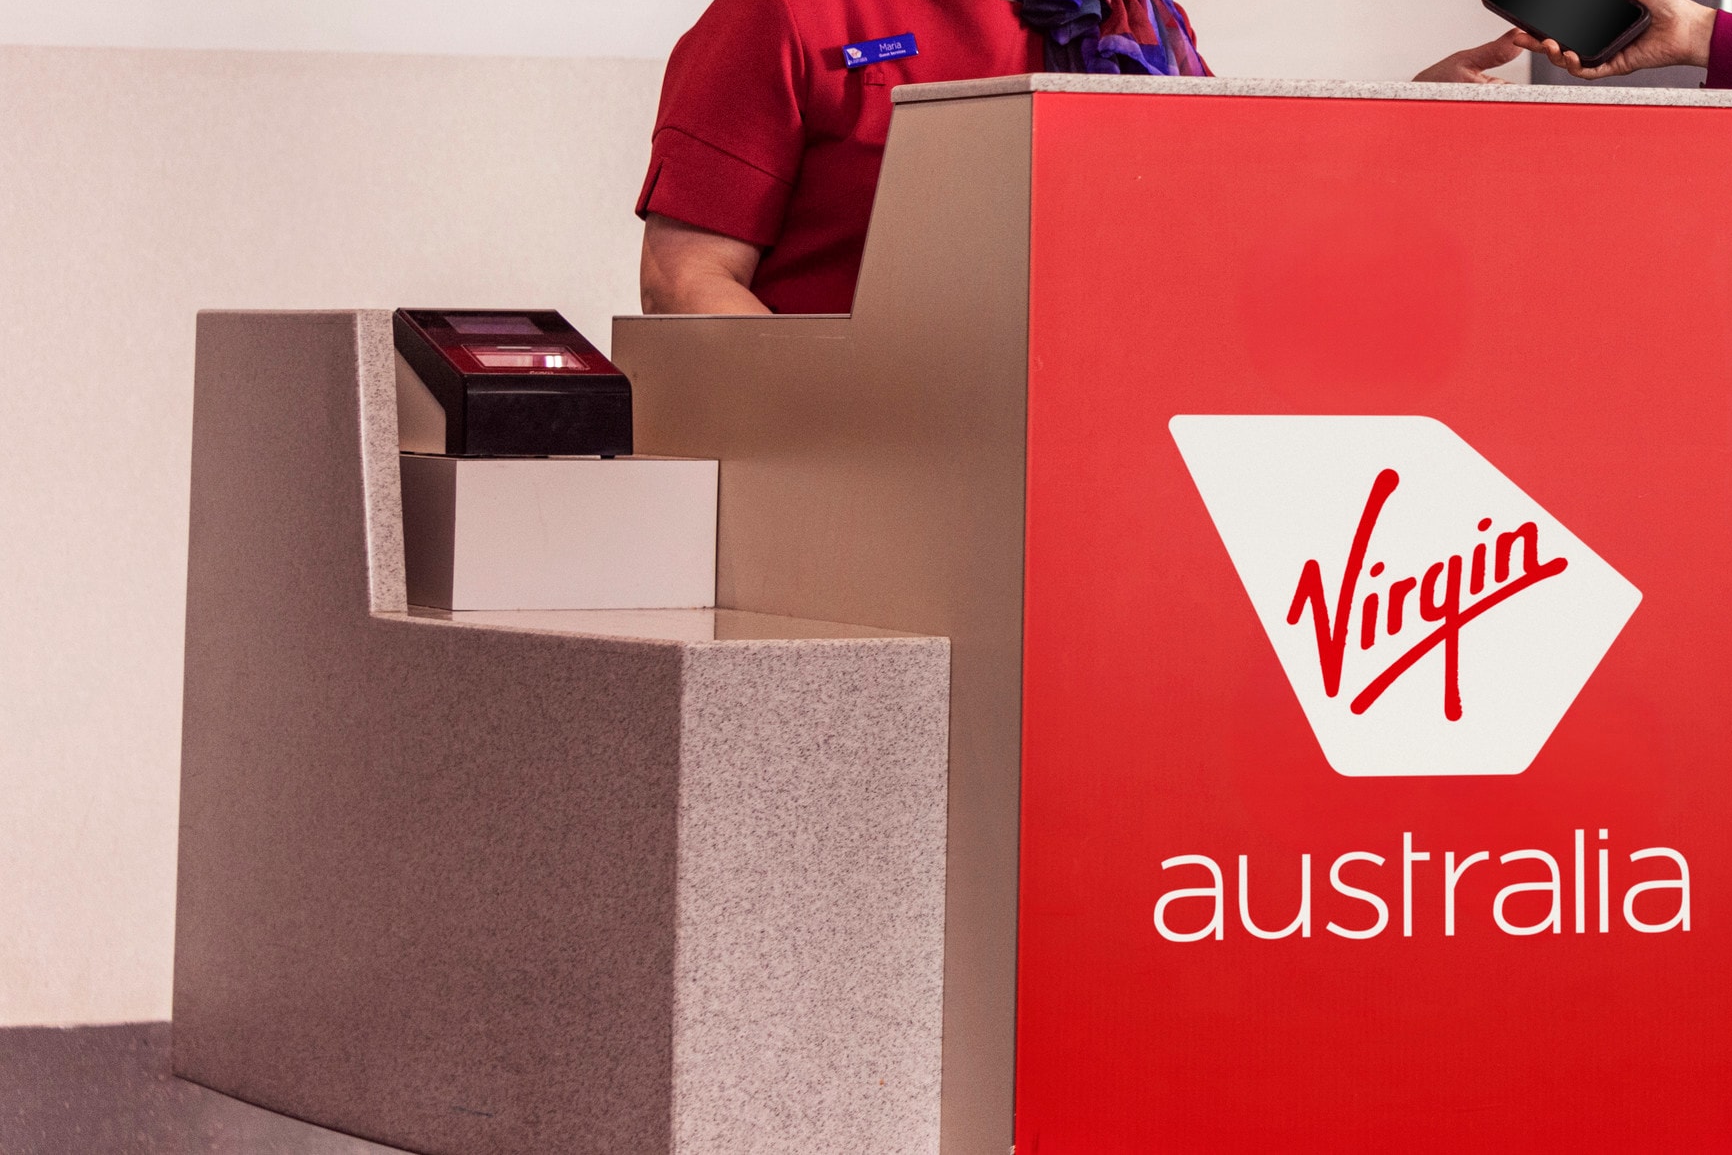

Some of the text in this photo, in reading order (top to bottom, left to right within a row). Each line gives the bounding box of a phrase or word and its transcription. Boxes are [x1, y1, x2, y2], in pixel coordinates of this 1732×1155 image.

[879, 41, 902, 52] Maria
[1286, 468, 1568, 721] Virgin
[1153, 828, 1691, 943] australia
